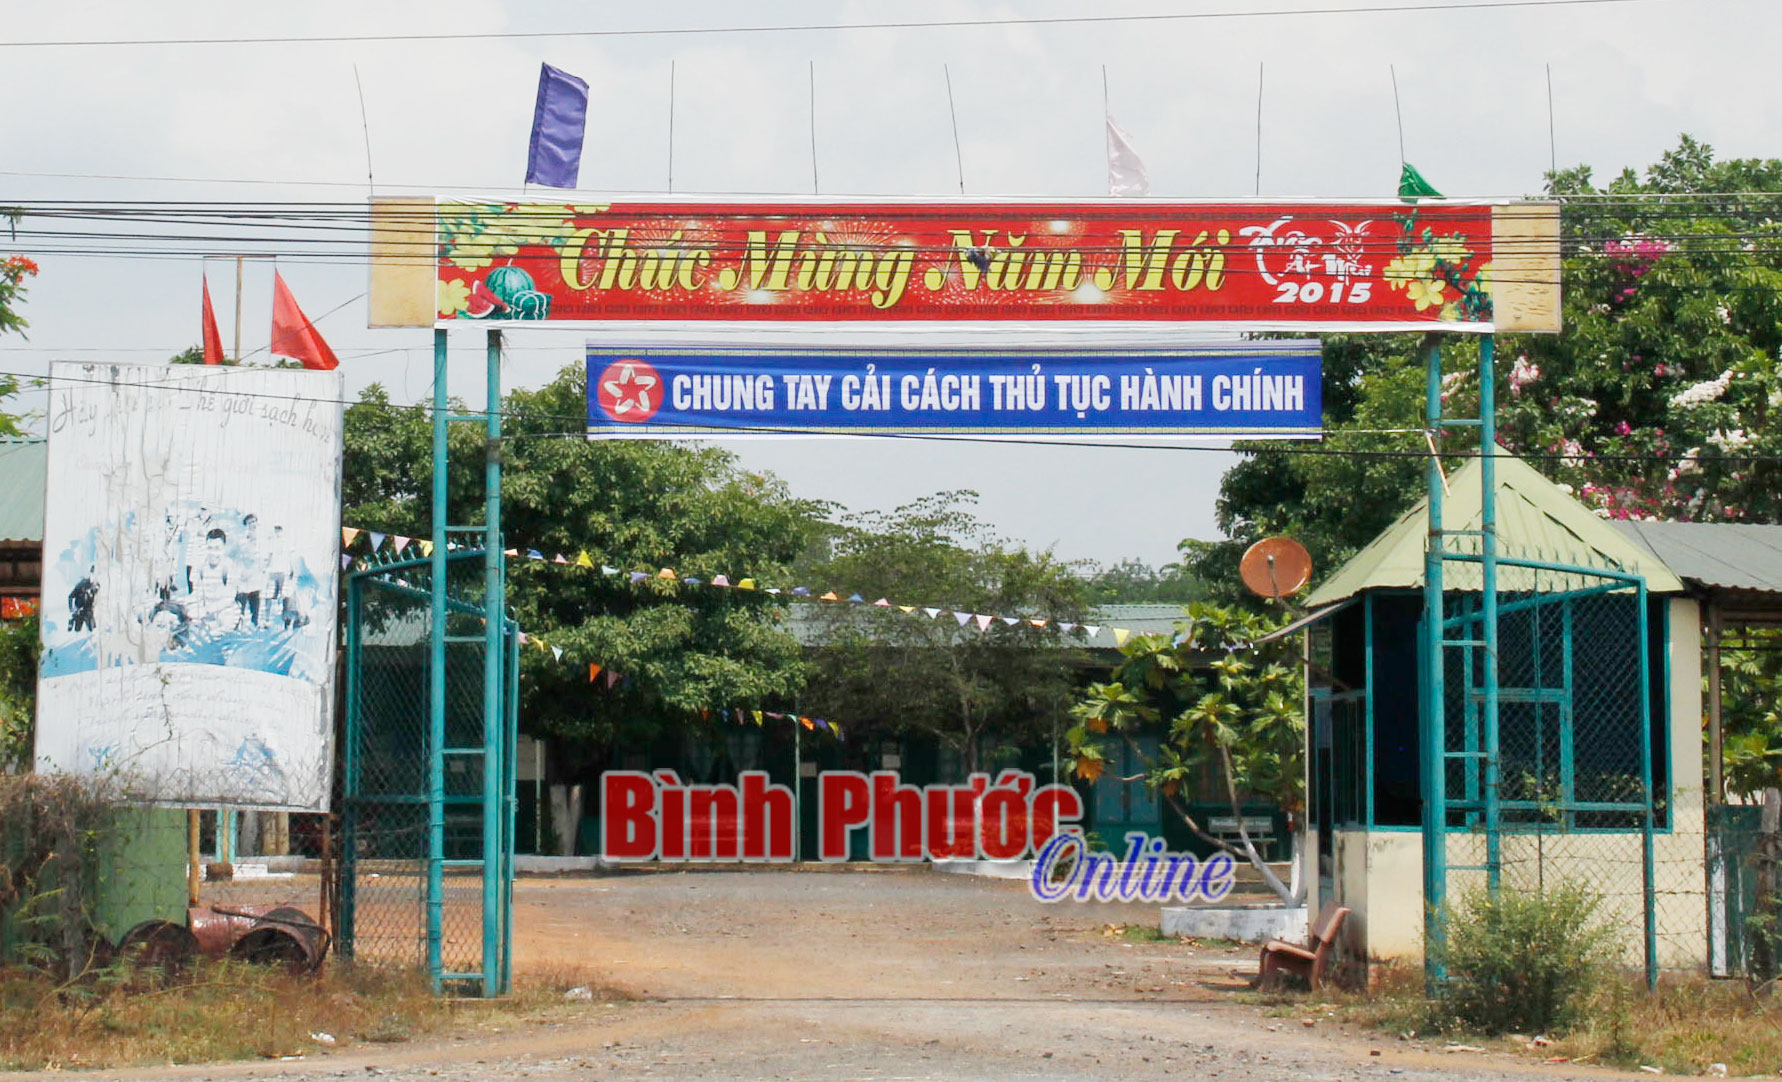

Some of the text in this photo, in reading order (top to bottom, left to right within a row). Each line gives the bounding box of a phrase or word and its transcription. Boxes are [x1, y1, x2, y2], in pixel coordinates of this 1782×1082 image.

[560, 228, 710, 291] Chúc
[924, 229, 1082, 291] Năm
[1094, 229, 1231, 291] Mới
[1272, 282, 1373, 303] 2015
[672, 364, 1304, 419] CHUNG TAY CẢI CÁCH THỦ TỤC HÀNH CHÍNH
